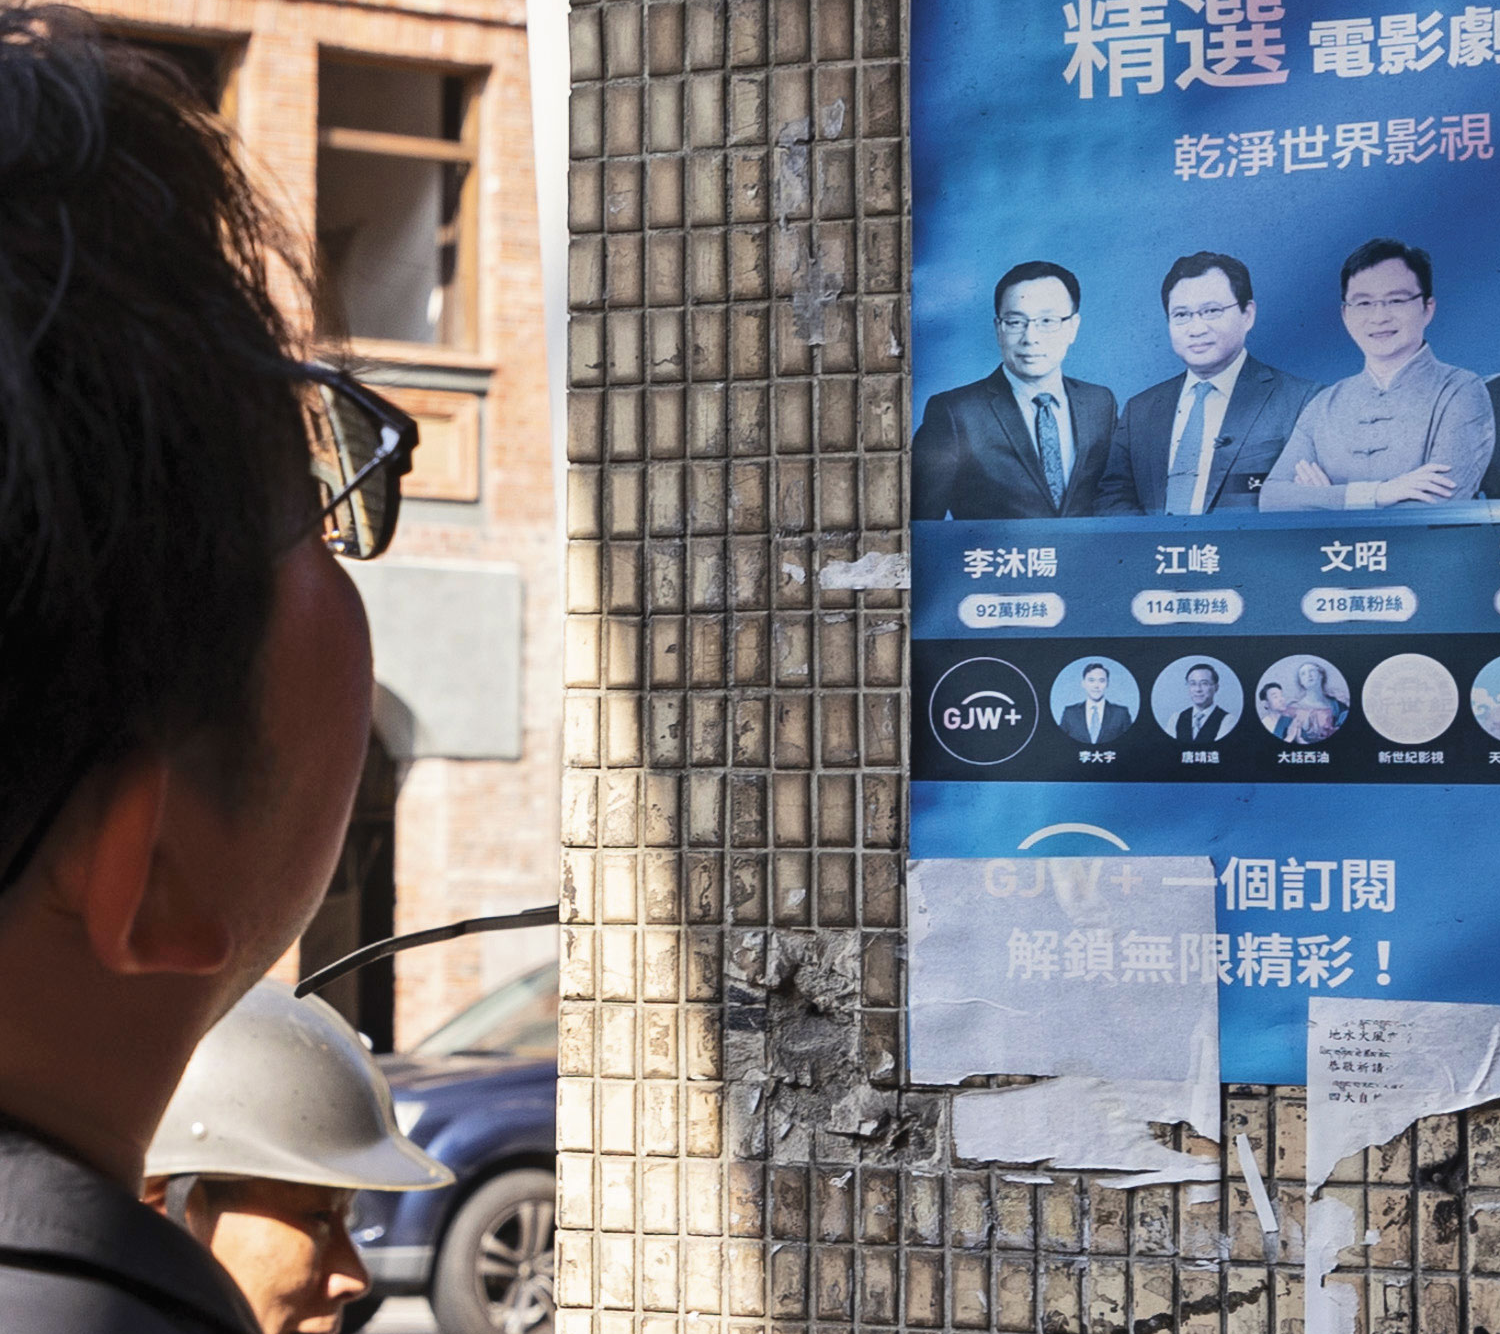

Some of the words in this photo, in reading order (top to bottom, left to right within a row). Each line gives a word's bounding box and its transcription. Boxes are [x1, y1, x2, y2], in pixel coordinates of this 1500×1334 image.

[1173, 113, 1495, 182] 乾淨世界影視
[963, 546, 1058, 579] 李沐陽
[1155, 544, 1221, 576] 江峰
[1319, 540, 1388, 574] 文昭
[975, 600, 1049, 620] 92萬粉絲
[1146, 596, 1229, 617] 114萬粉絲
[1315, 594, 1403, 614] 218萬粉絲
[943, 706, 1022, 731] GJW+
[1378, 750, 1445, 765] 新世紀影視
[1161, 857, 1397, 913] 一個訂閱
